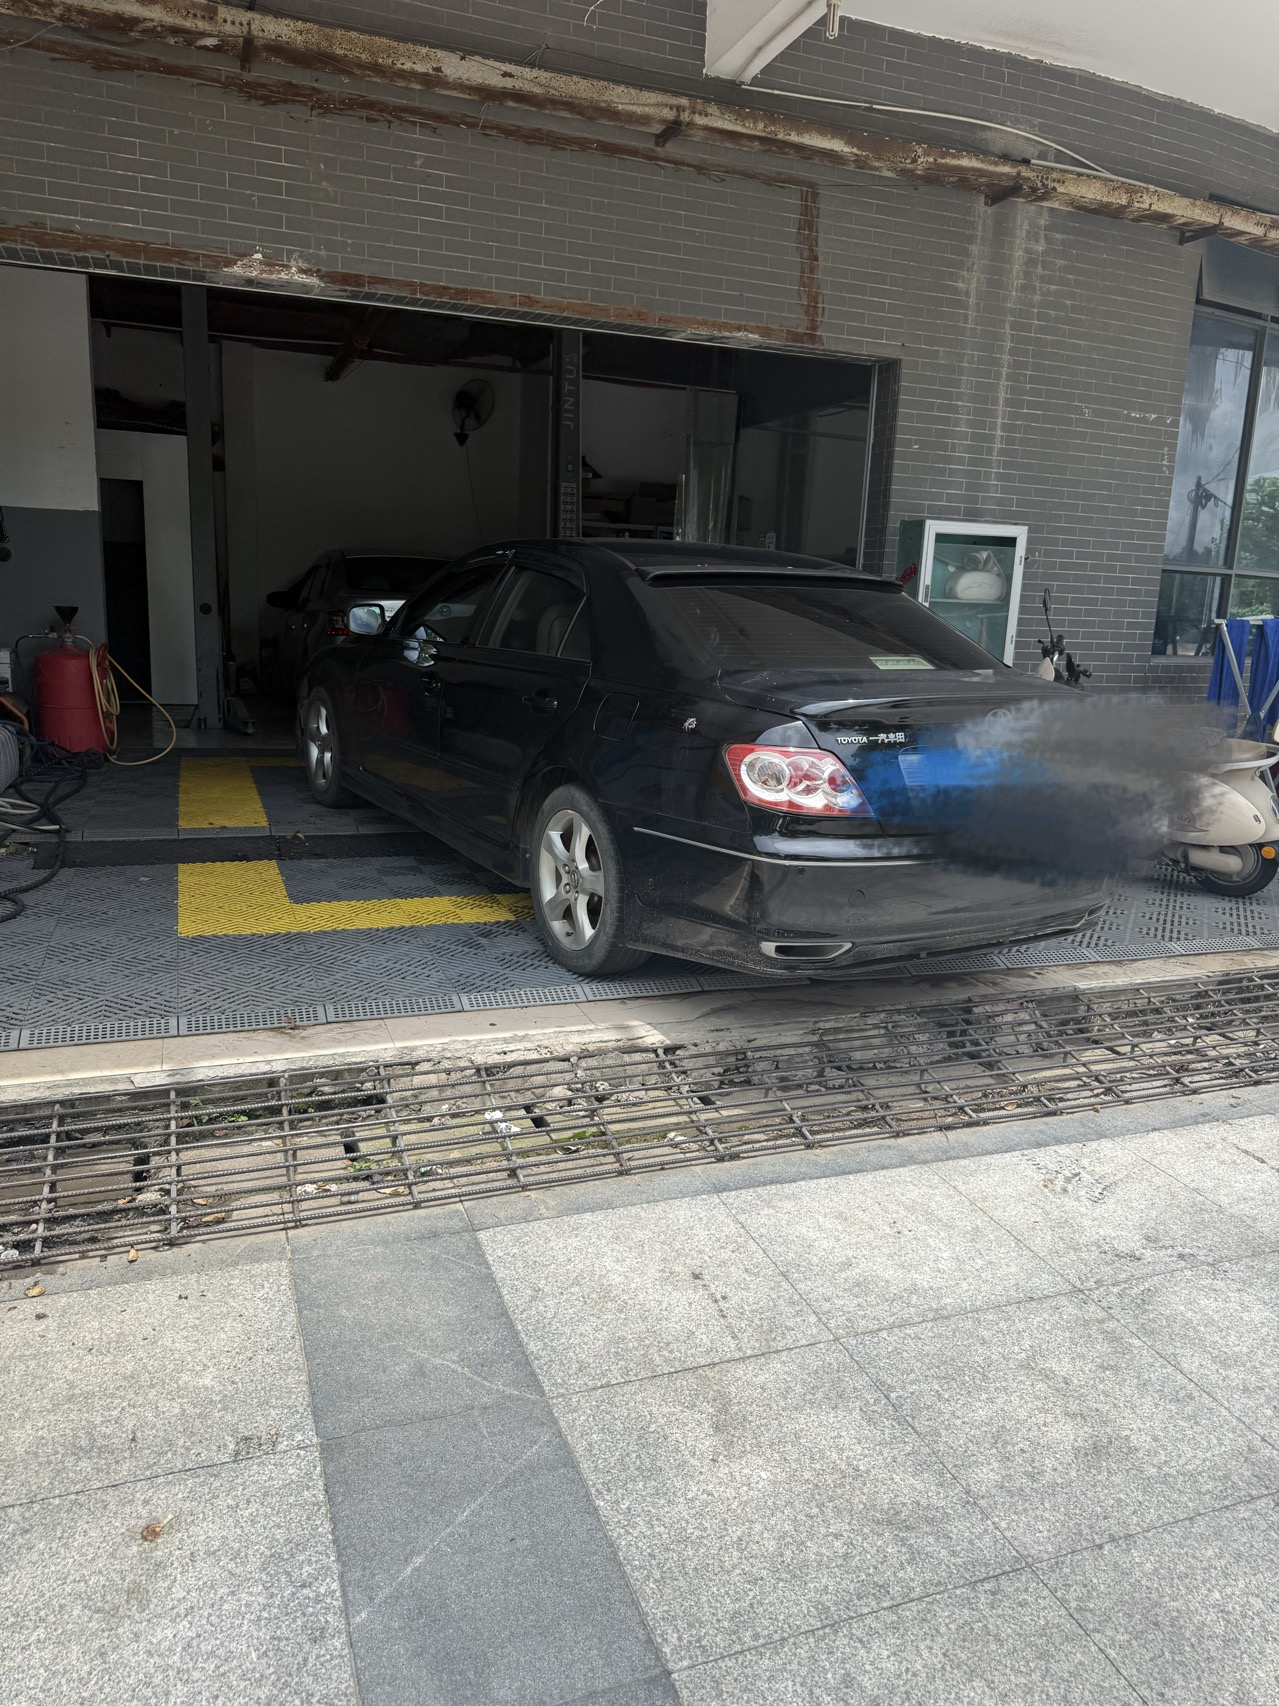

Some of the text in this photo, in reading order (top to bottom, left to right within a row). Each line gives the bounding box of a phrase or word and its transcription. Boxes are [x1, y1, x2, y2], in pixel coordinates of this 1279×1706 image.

[836, 732, 905, 744] TOYOTA 一汽丰田
